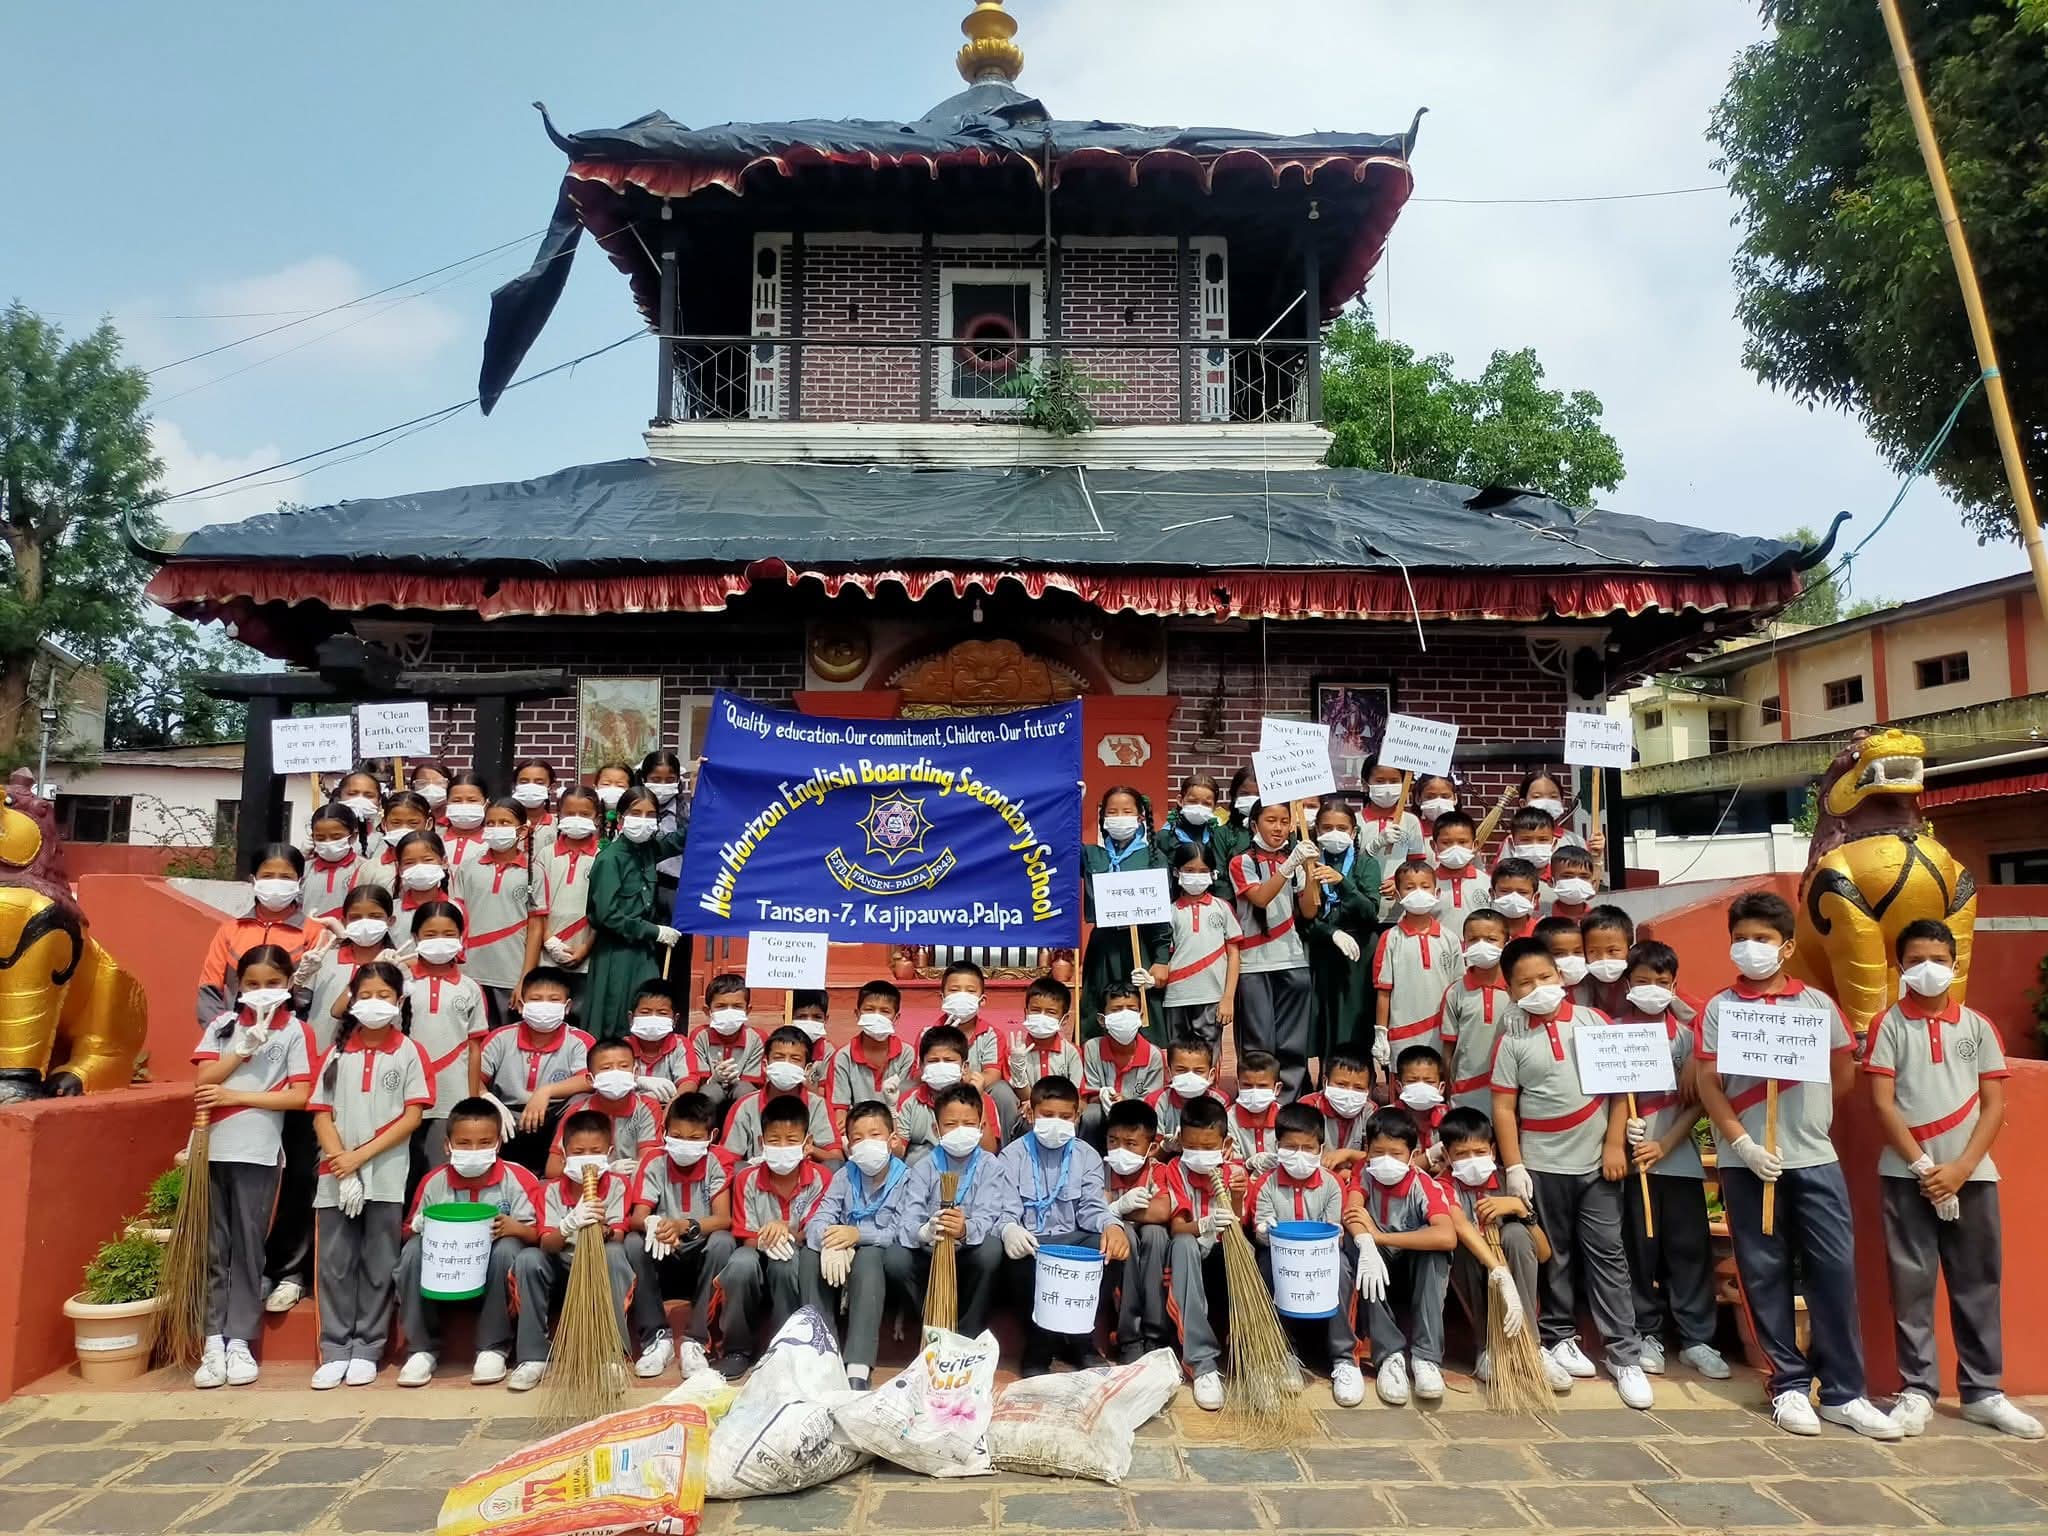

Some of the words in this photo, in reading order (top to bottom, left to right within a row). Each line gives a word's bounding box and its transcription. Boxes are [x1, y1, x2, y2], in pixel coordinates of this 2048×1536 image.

[396, 725, 424, 734] Green
[1411, 724, 1428, 733] part
[1440, 729, 1453, 738] the
[1289, 749, 1304, 758] NO
[1423, 743, 1436, 752] not
[1438, 745, 1450, 754] the
[1301, 761, 1317, 770] Say
[1263, 782, 1282, 791] YES
[699, 869, 737, 920] New
[718, 800, 788, 873] Horizon
[777, 762, 858, 808] English
[859, 757, 956, 797] Boarding
[955, 766, 1038, 852] Secondary
[1023, 843, 1062, 923] School
[768, 952, 806, 963] breathe
[1742, 1051, 1768, 1062] सफा
[936, 1352, 987, 1374] eries
